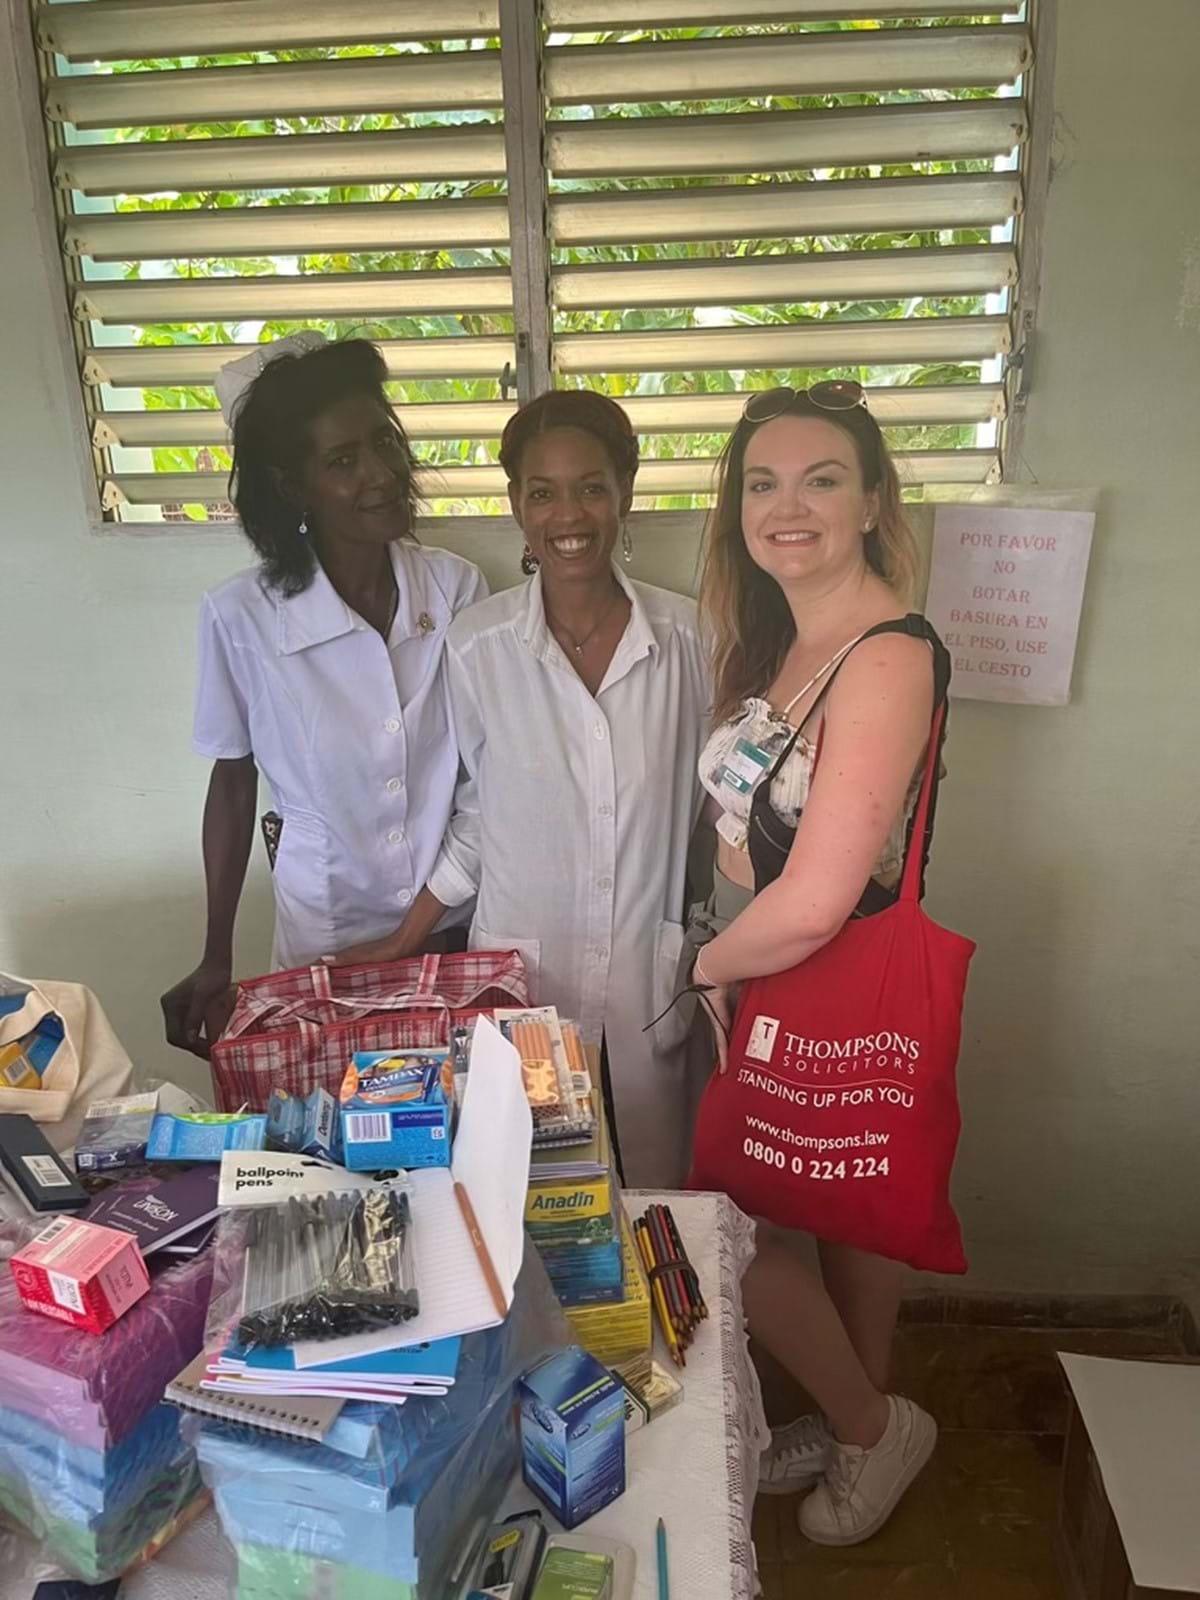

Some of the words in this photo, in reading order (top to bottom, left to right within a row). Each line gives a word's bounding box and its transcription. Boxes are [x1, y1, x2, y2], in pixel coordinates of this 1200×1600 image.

[959, 532, 992, 548] POR
[998, 534, 1057, 551] FAVOR
[993, 560, 1016, 574] NO
[972, 586, 1030, 604] BOTAR
[950, 609, 1019, 628] BASURA
[1025, 616, 1048, 629] EN
[944, 633, 964, 647] EL
[969, 636, 1010, 652] PISO,
[1015, 641, 1048, 655] USE
[954, 658, 974, 672] EL
[978, 660, 1032, 678] CESTO
[763, 1022, 774, 1039] T
[784, 1031, 920, 1060] THOMPSONS
[783, 1055, 916, 1075] SOLICITORS
[737, 1068, 808, 1105] STANDING
[813, 1093, 836, 1108] UP
[840, 1087, 874, 1106] FOR
[878, 1087, 915, 1109] YOU
[745, 1115, 890, 1153] www.thompsons.law
[743, 1137, 786, 1169] 0800
[791, 1158, 803, 1174] 0
[809, 1160, 846, 1180] 224
[853, 1156, 890, 1178] 224
[236, 1167, 305, 1179] ballpoint
[235, 1179, 274, 1191] pens
[531, 1191, 595, 1210] Anadin
